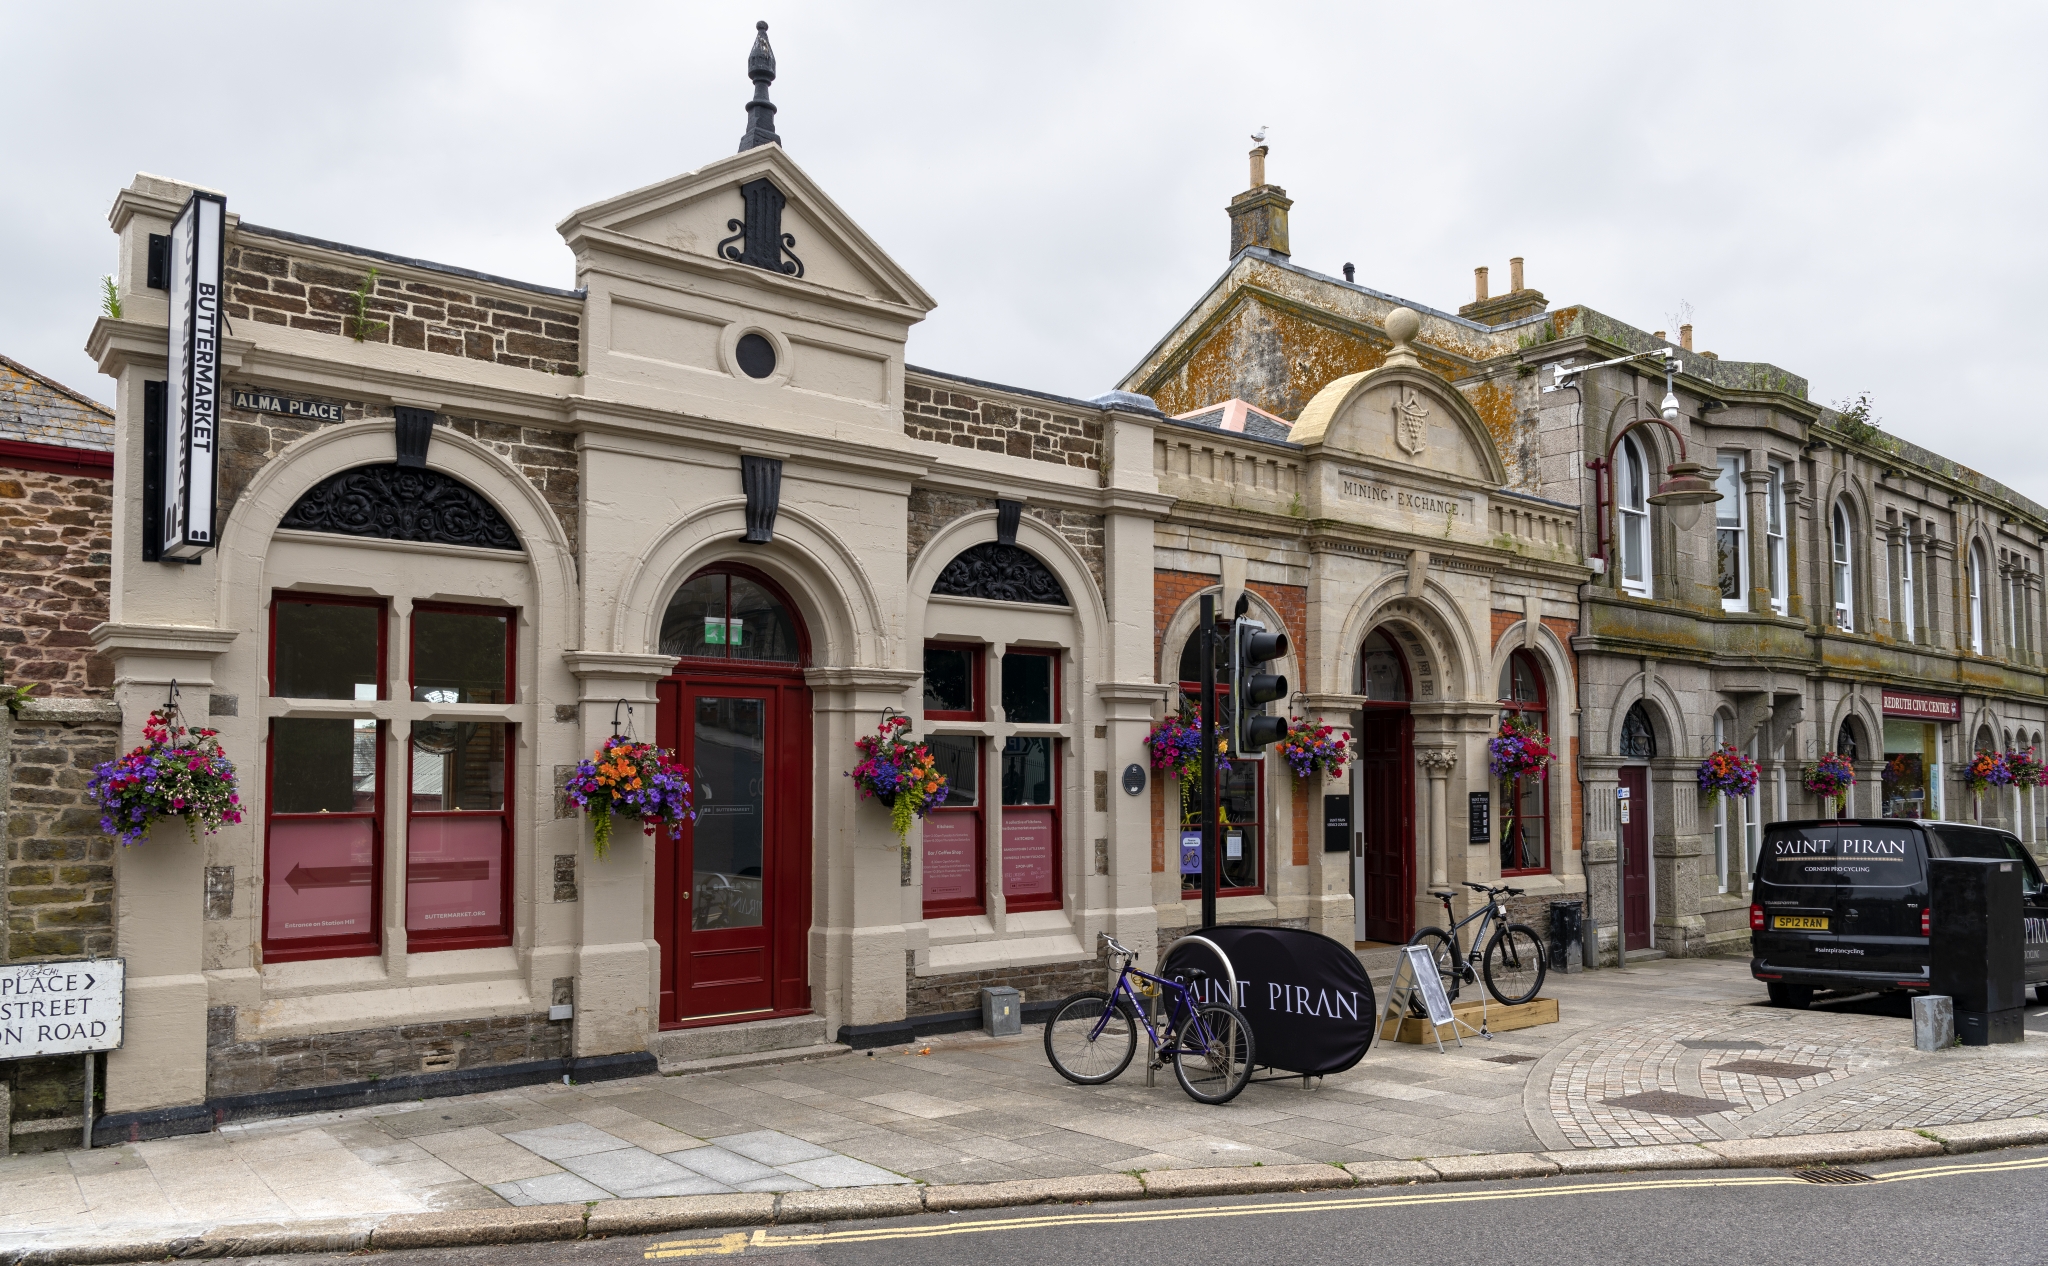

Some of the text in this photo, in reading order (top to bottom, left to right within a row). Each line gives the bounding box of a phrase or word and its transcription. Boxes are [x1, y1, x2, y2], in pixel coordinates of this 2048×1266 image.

[193, 282, 216, 453] BUTTERMARKET
[236, 393, 339, 419] ALMA PLACE
[1883, 696, 1950, 713] REDRUTH CIVIC CENTRE
[1775, 839, 1906, 855] SAINT PIRAN
[284, 921, 312, 929] Entrance
[321, 919, 344, 927] Station
[344, 918, 355, 926] Hill
[424, 910, 486, 920] BUTTERMARKET.ORG
[1779, 917, 1823, 927] SP12 RAN
[2023, 917, 2048, 944] PIRA
[1814, 947, 1865, 955] #saintpirancycling
[2, 974, 78, 996] PLACE
[1, 998, 93, 1020] STREET
[1174, 975, 1359, 1021] SAINT PIRAN
[0, 1021, 107, 1045] N ROAD
